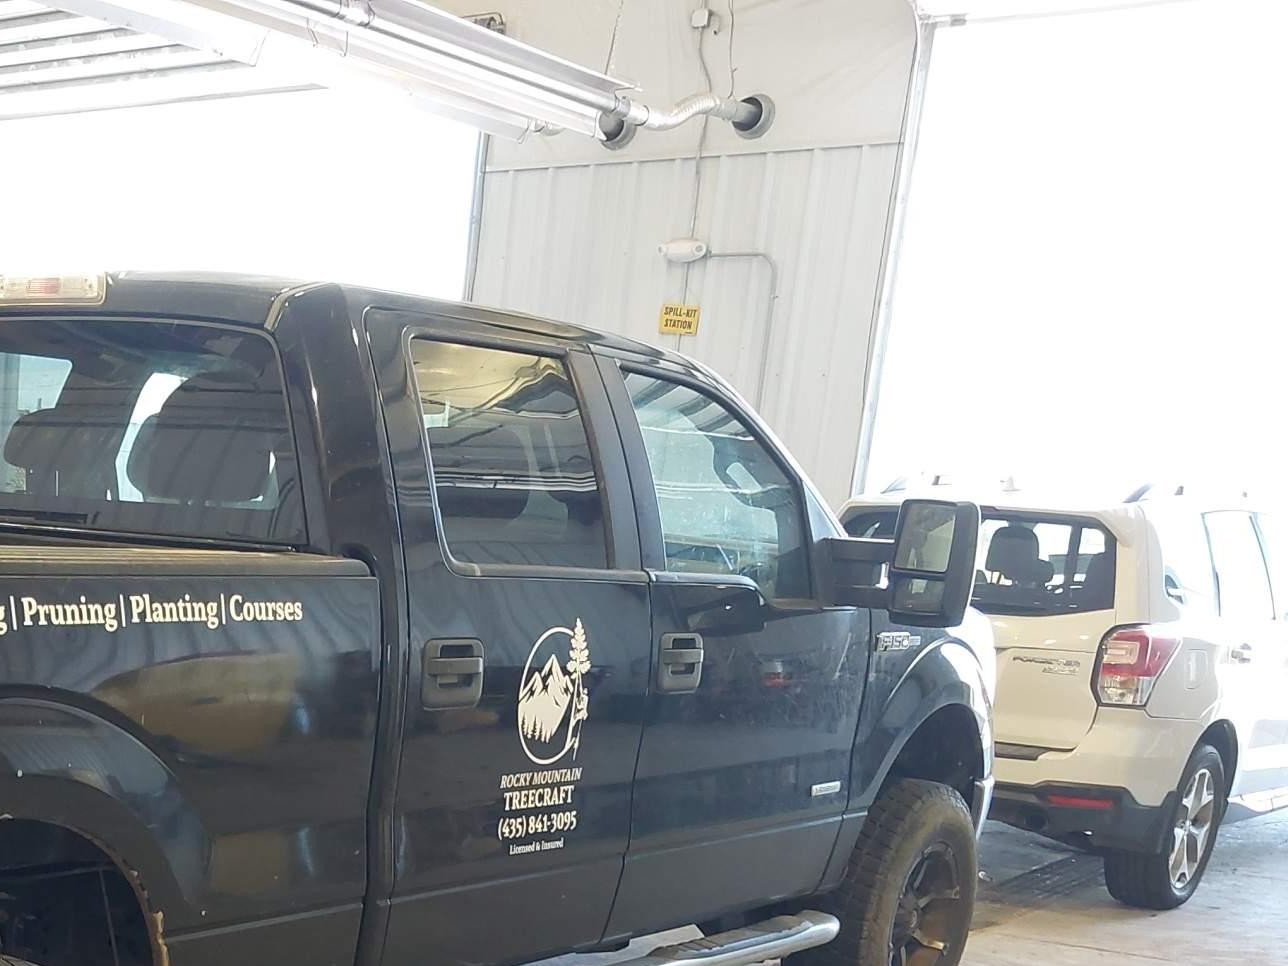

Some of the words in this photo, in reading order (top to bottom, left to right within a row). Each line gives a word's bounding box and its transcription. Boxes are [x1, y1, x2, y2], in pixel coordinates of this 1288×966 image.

[664, 306, 697, 318] SPILL-KIT
[664, 318, 693, 330] STATION
[21, 596, 118, 633] Pruning
[129, 593, 219, 629] Planting
[229, 594, 303, 622] Courses
[500, 772, 532, 789] ROCKY
[532, 767, 582, 785] MOUNTAIN
[503, 785, 574, 811] TREECRAFT
[497, 815, 527, 840] (435)
[528, 810, 577, 834] 841-3095
